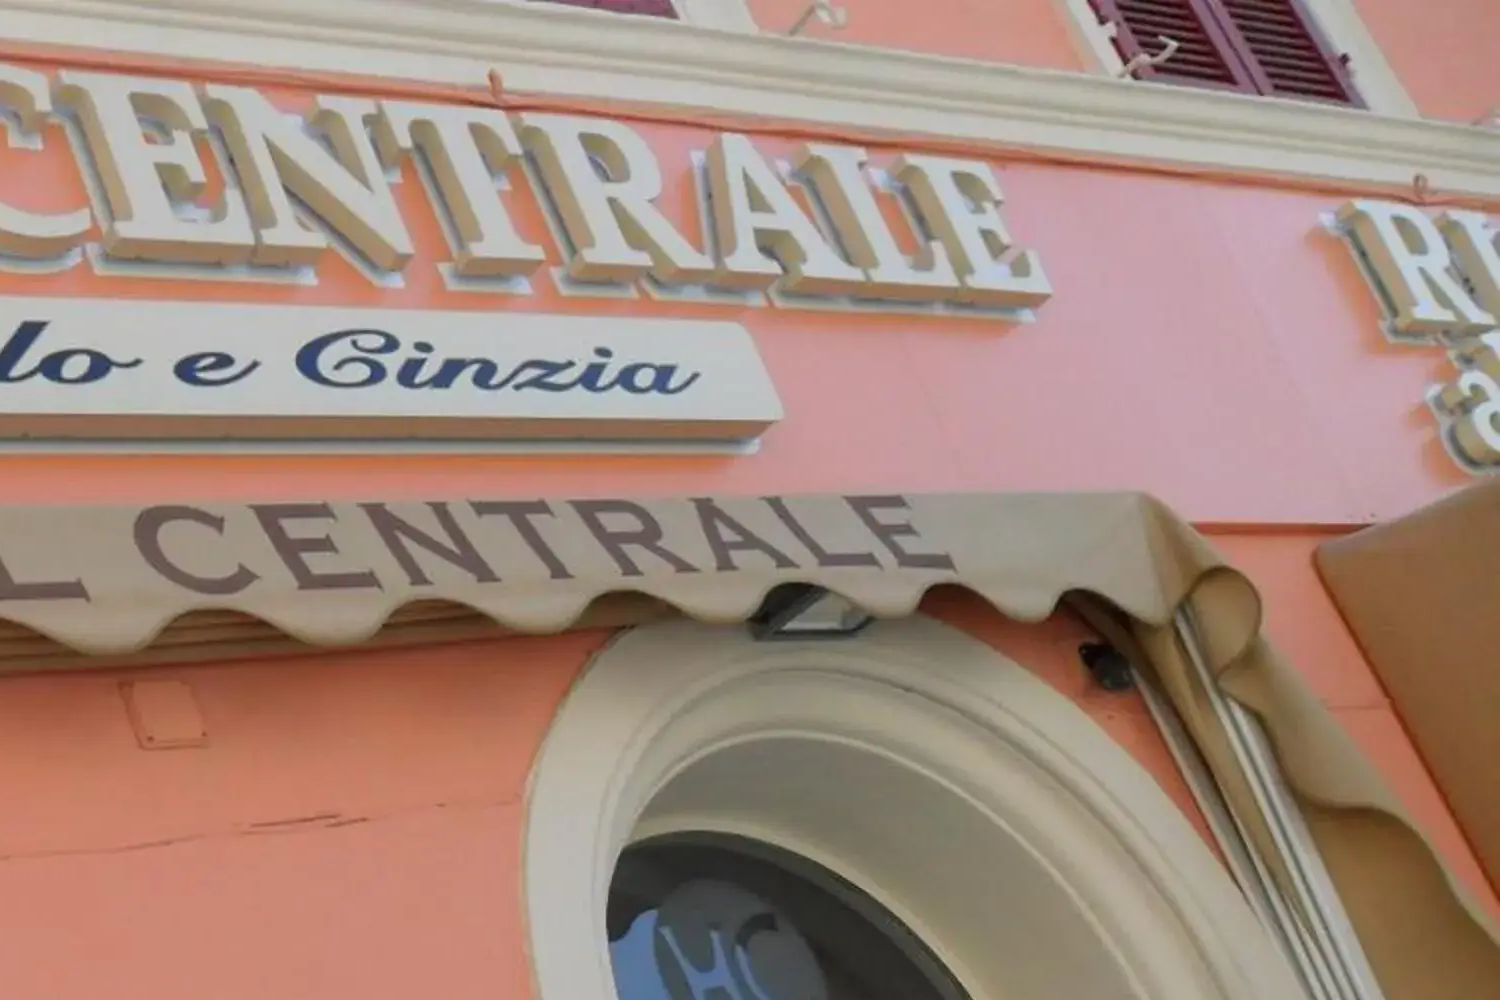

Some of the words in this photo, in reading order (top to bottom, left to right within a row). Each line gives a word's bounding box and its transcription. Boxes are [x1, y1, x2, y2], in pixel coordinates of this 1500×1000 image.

[173, 350, 262, 388] e
[298, 328, 700, 395] Cinzia
[133, 494, 958, 596] CENTRALE
